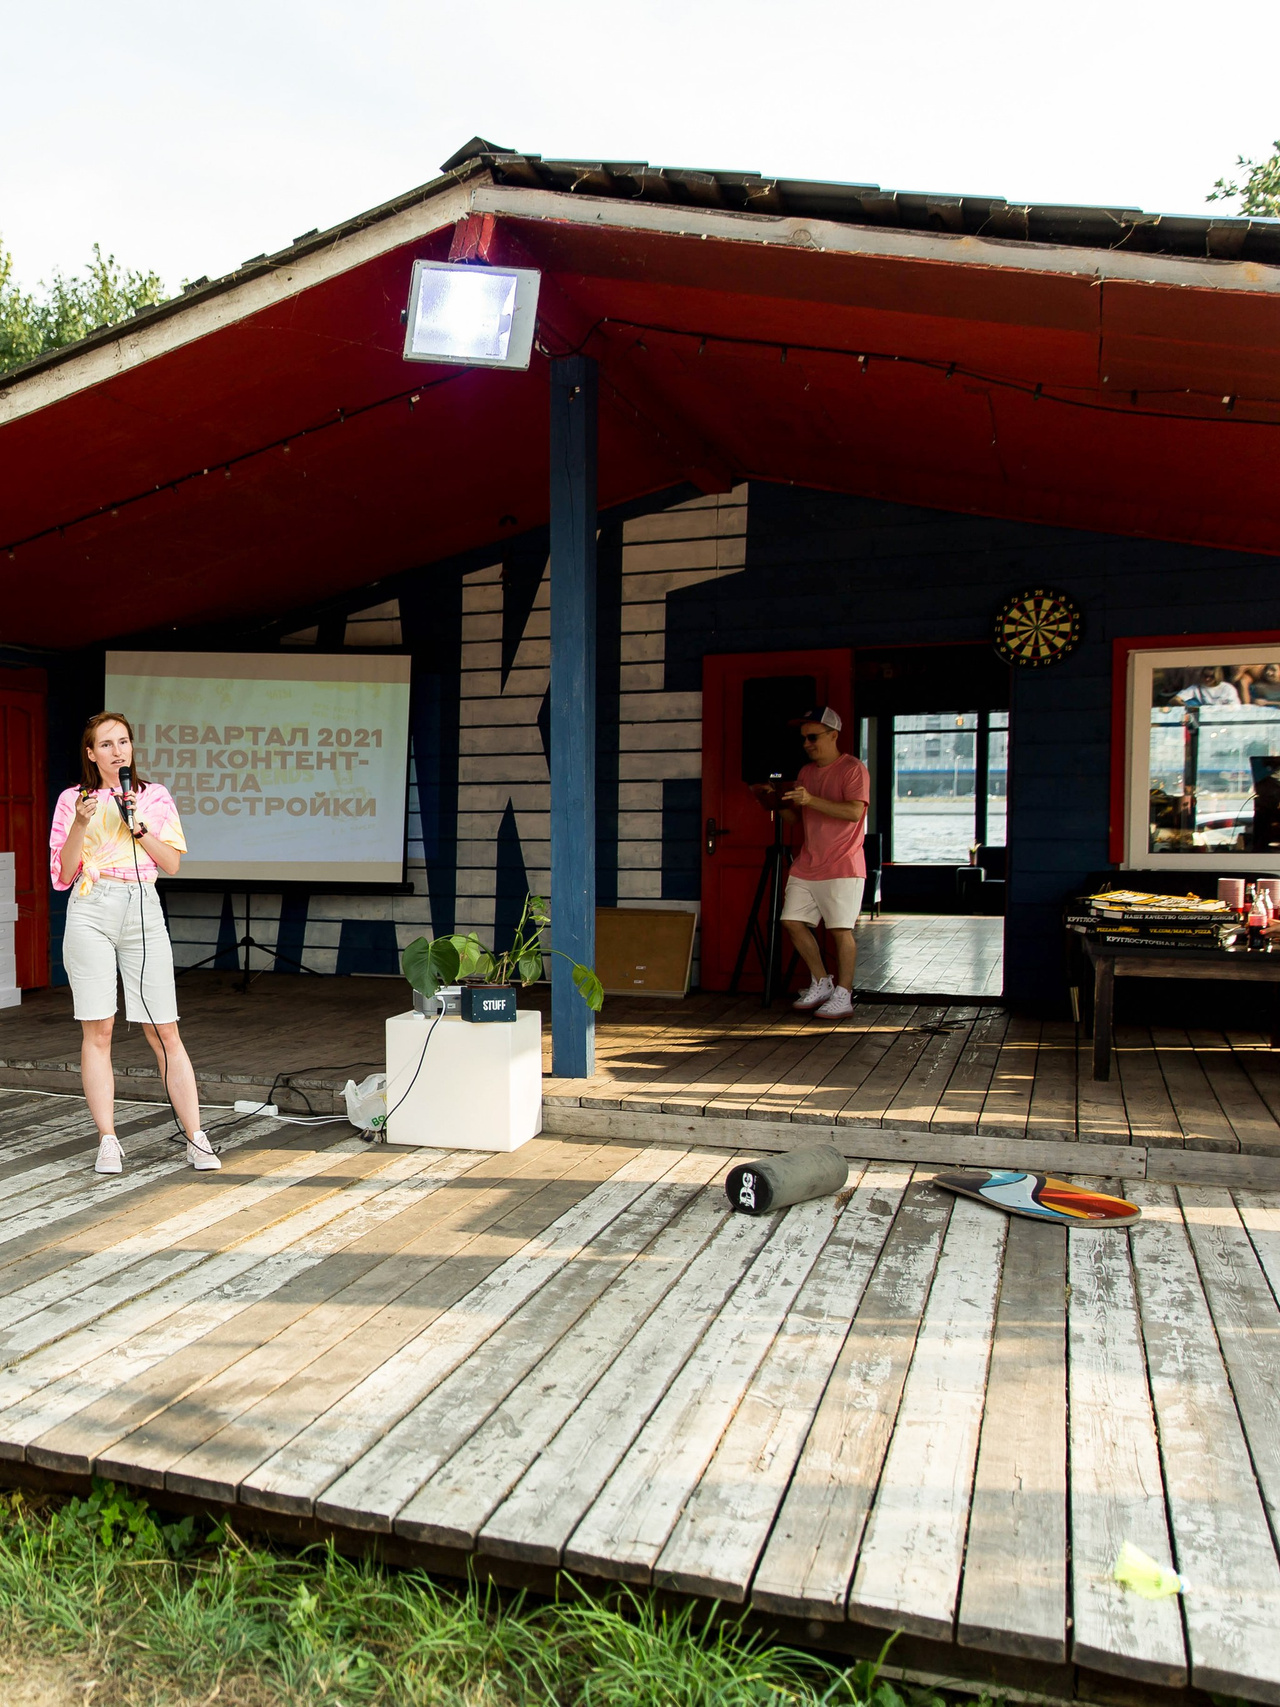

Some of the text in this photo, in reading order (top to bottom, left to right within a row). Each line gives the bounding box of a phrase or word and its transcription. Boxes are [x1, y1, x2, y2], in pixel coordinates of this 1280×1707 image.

[155, 724, 309, 747] КВАРТАЛ
[317, 728, 383, 748] 2021
[133, 748, 369, 771] ДЛЯ КОНТЕНТ-
[137, 771, 263, 796] ТДЕЛА
[176, 791, 377, 817] ВОСТРОЙКИ
[482, 999, 506, 1011] STUFF
